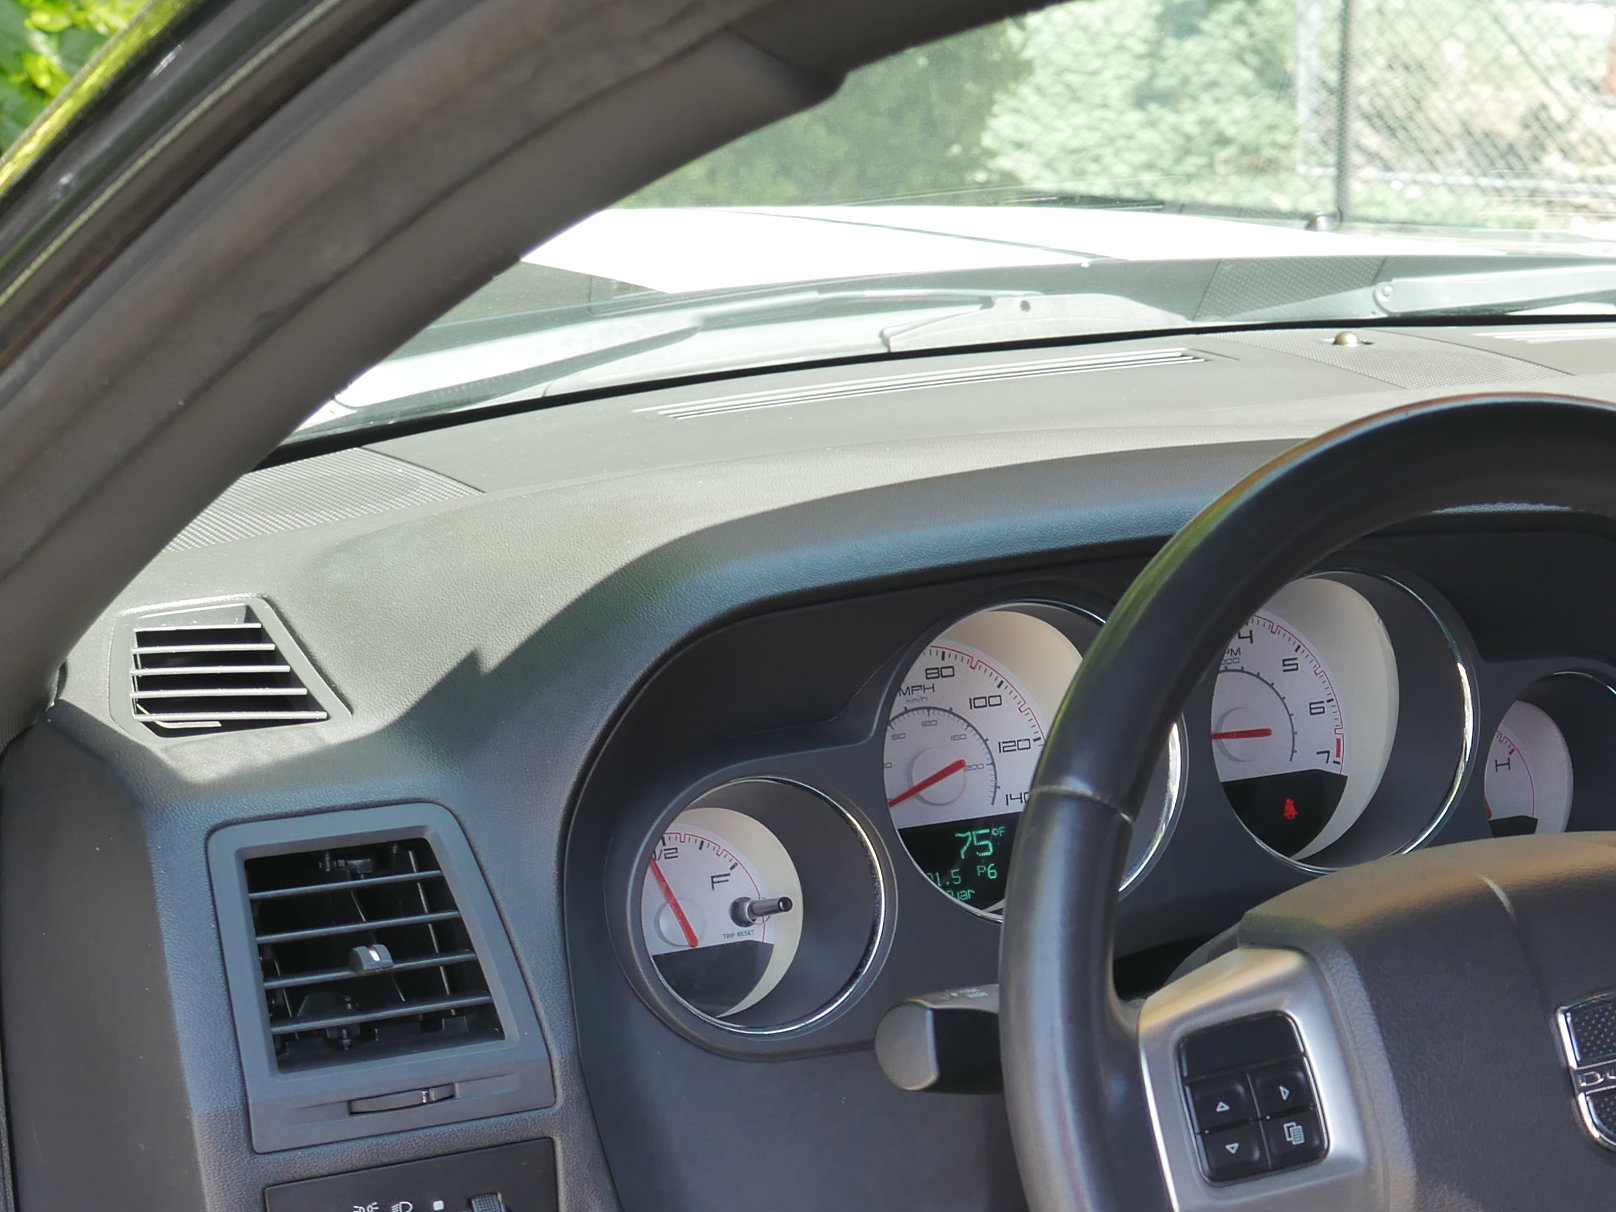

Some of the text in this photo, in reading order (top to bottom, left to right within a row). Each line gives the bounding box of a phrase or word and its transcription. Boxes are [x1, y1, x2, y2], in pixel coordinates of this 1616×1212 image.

[1238, 630, 1254, 644] 4
[924, 665, 955, 680] 80
[1282, 657, 1299, 673] 5
[898, 683, 935, 697] MPH
[968, 694, 1003, 710] 100
[1309, 700, 1326, 716] 6
[997, 737, 1032, 754] 120
[1316, 749, 1331, 764] 7
[710, 872, 731, 891] F
